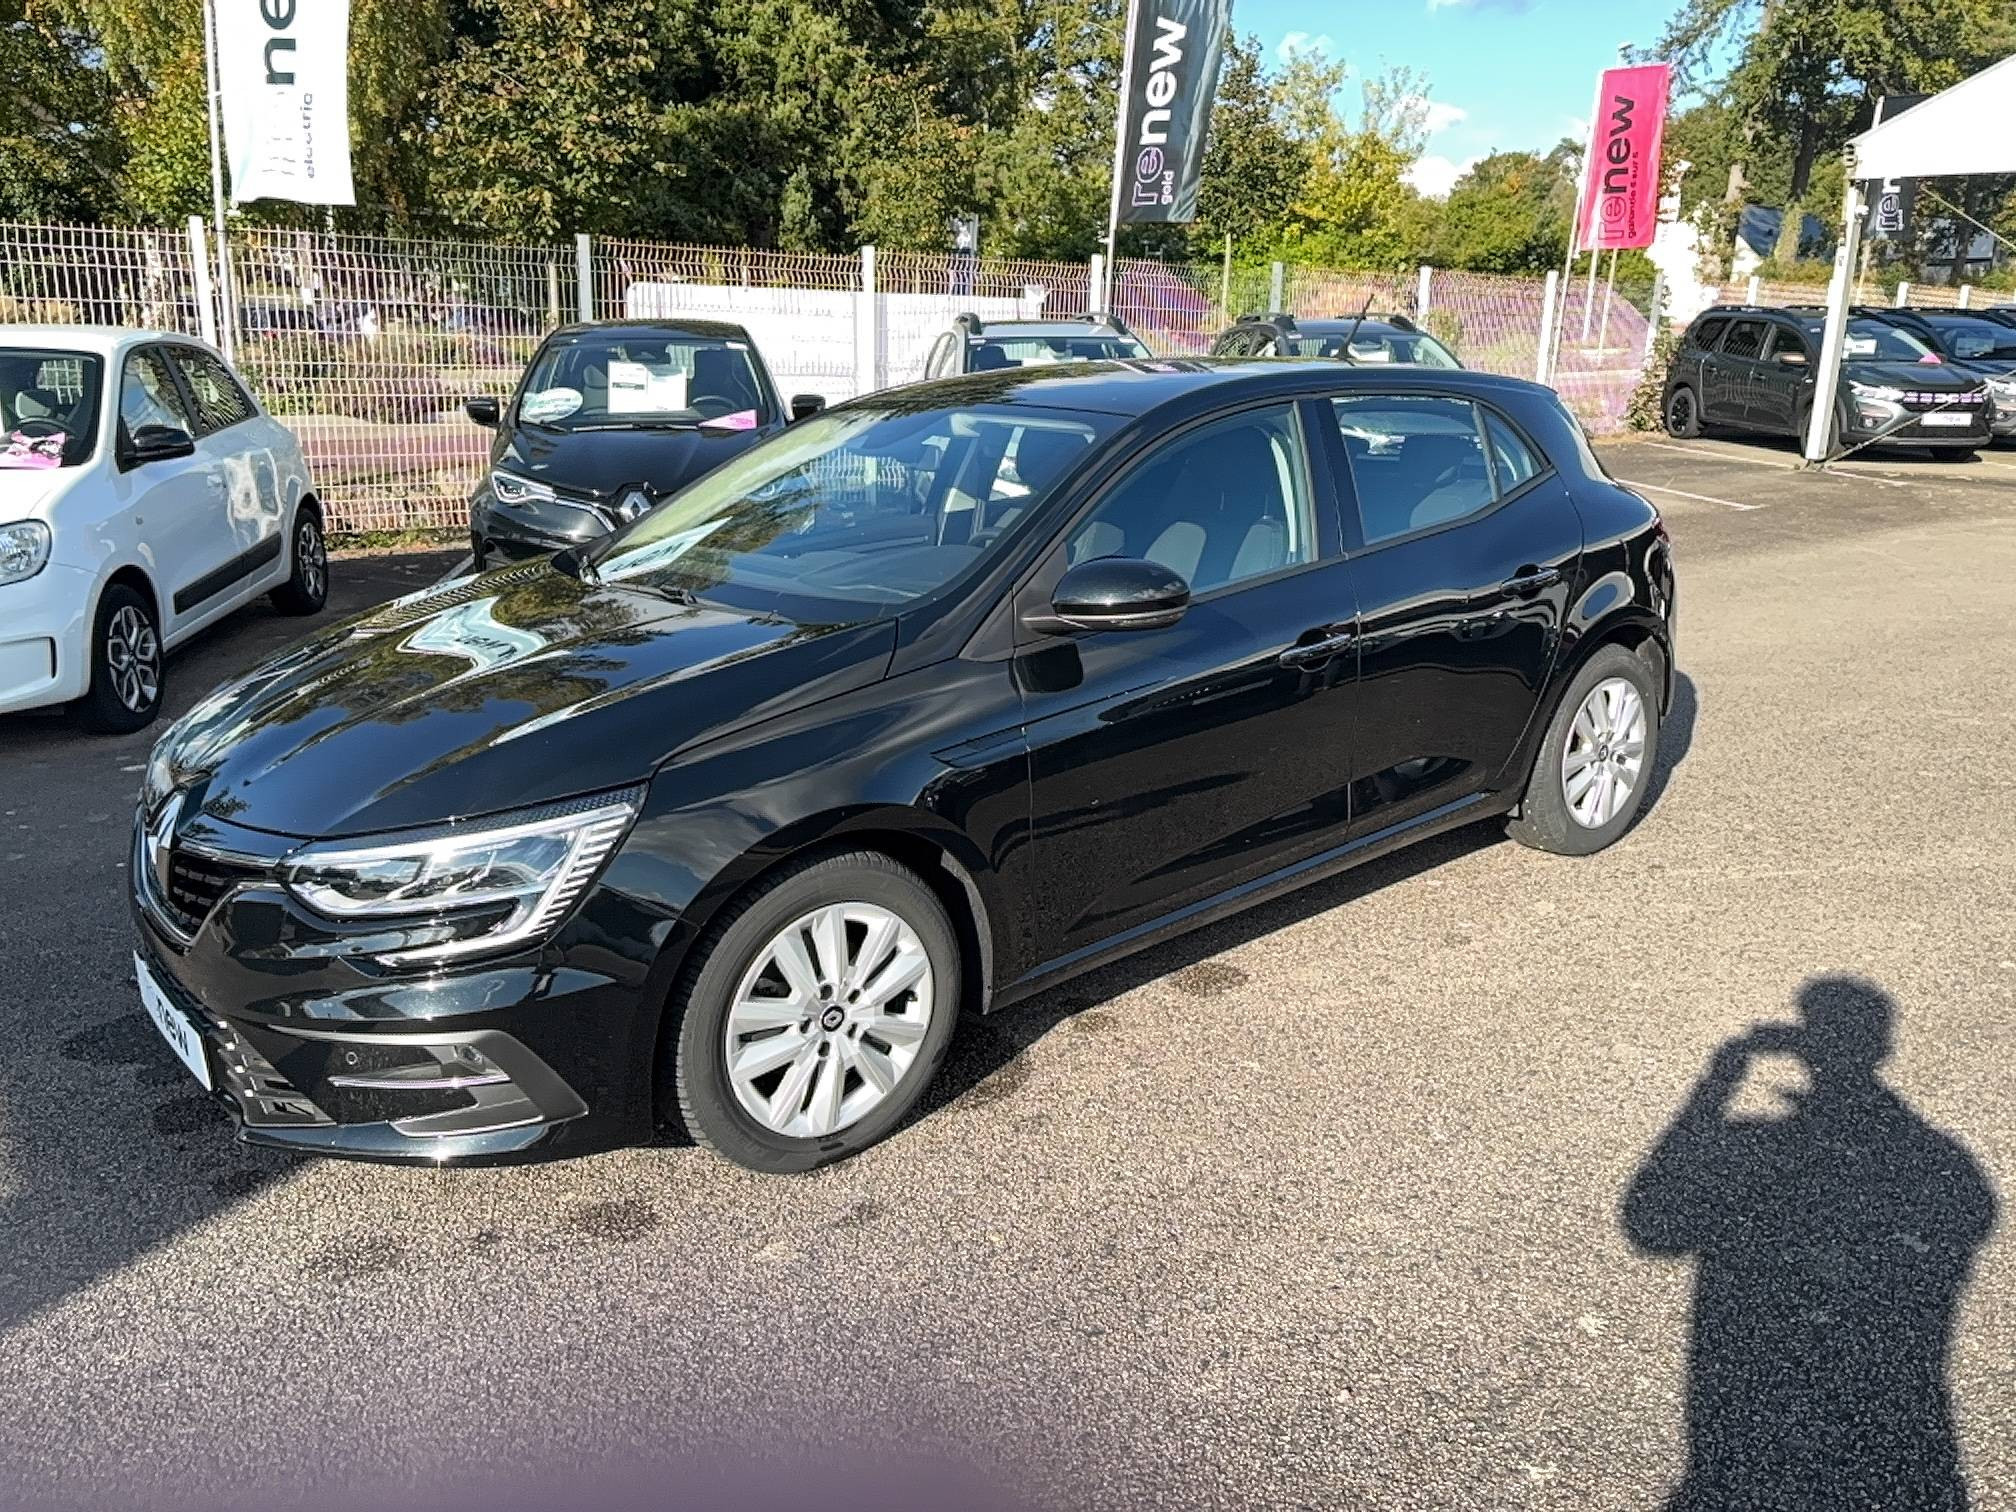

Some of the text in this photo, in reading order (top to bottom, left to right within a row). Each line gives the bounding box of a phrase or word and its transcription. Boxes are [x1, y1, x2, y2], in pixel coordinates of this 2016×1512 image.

[1132, 15, 1187, 207] renew
[1598, 95, 1635, 241] renew
[1161, 171, 1175, 205] gold
